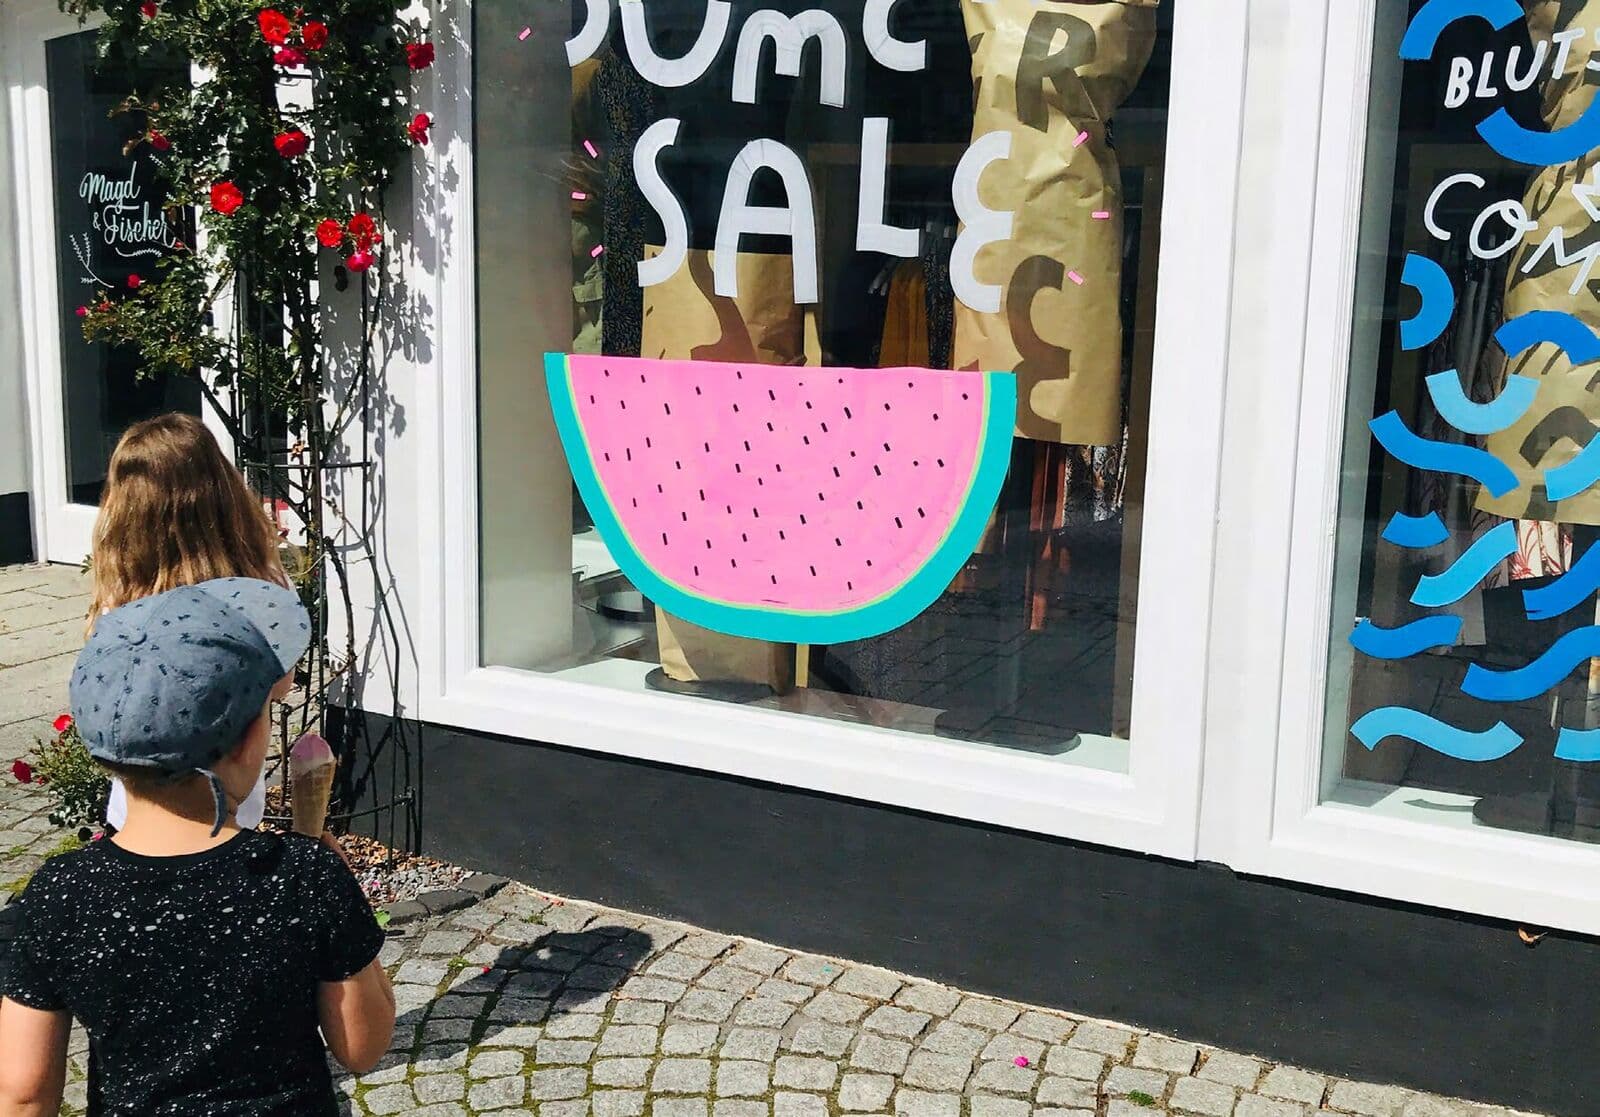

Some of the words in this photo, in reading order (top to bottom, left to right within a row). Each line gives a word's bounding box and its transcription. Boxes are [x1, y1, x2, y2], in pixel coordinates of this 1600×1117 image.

[79, 161, 141, 214] Magd
[92, 211, 102, 231] &
[103, 201, 176, 248] Fischer
[632, 117, 1013, 314] SALE
